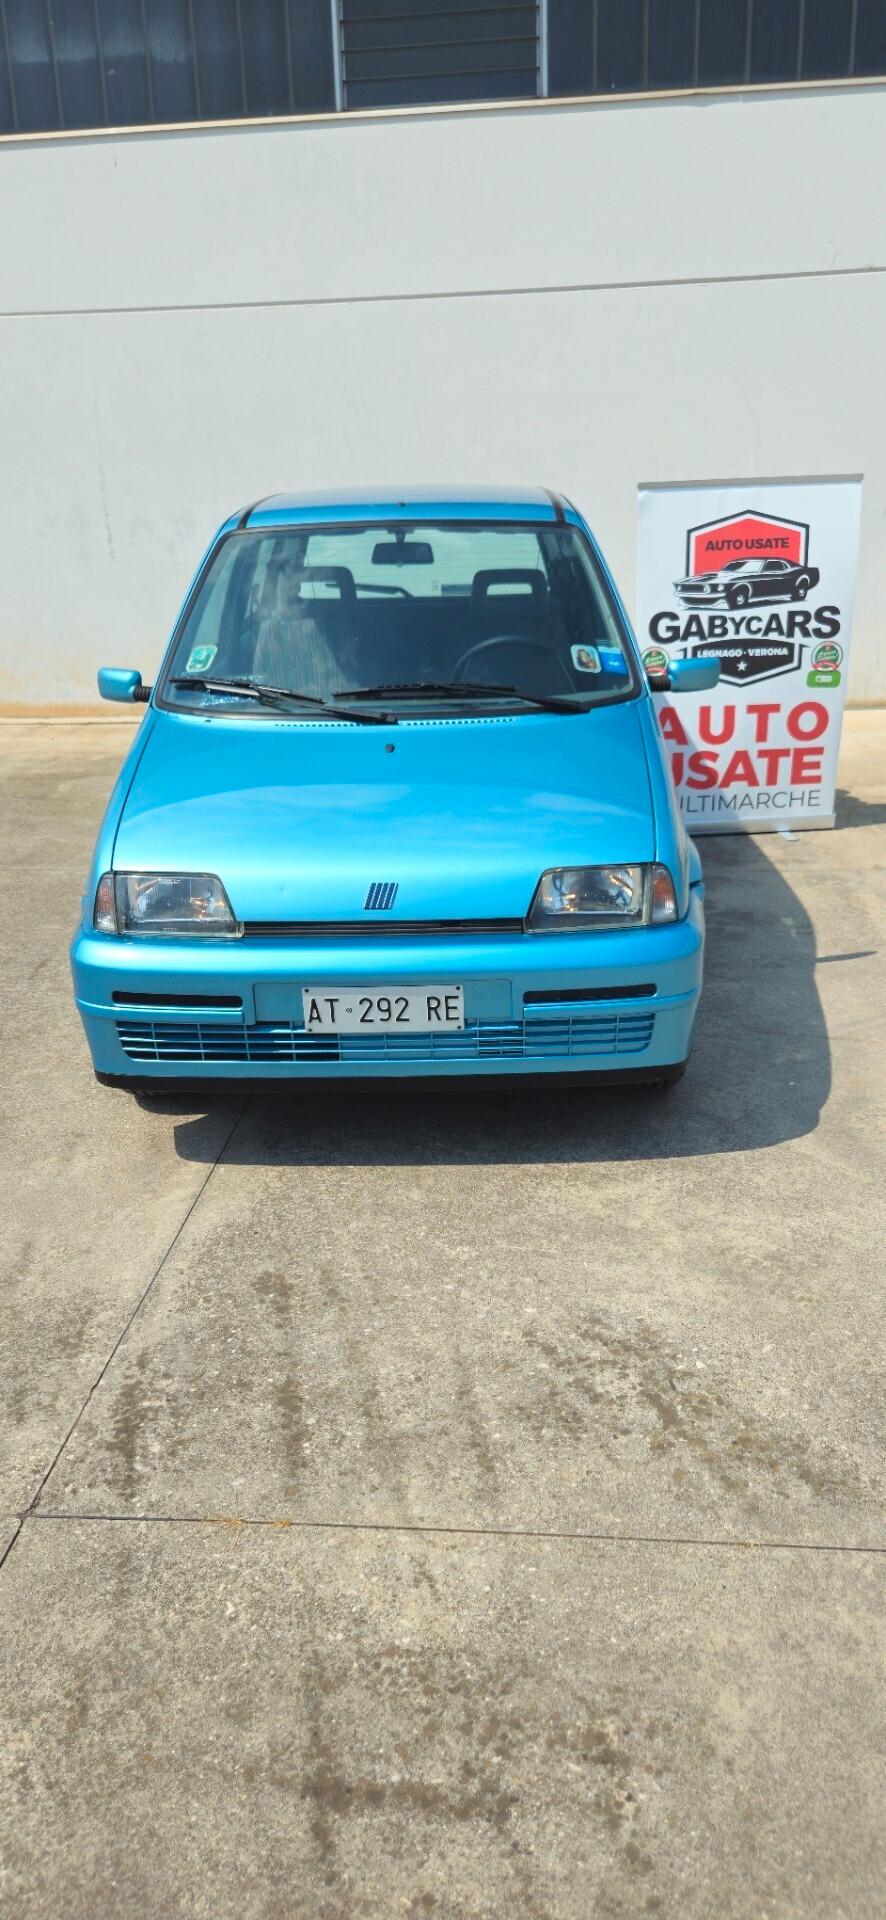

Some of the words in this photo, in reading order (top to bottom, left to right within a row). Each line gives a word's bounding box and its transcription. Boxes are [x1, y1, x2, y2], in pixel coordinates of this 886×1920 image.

[704, 539, 744, 552] AUTO
[745, 537, 790, 550] USATE
[648, 605, 841, 644] GABYCARS
[697, 648, 743, 659] LEGNAGO
[748, 647, 788, 657] VERONA
[658, 701, 829, 746] AUTO
[308, 998, 339, 1023] AT
[358, 997, 410, 1023] 292
[426, 995, 459, 1021] RE
